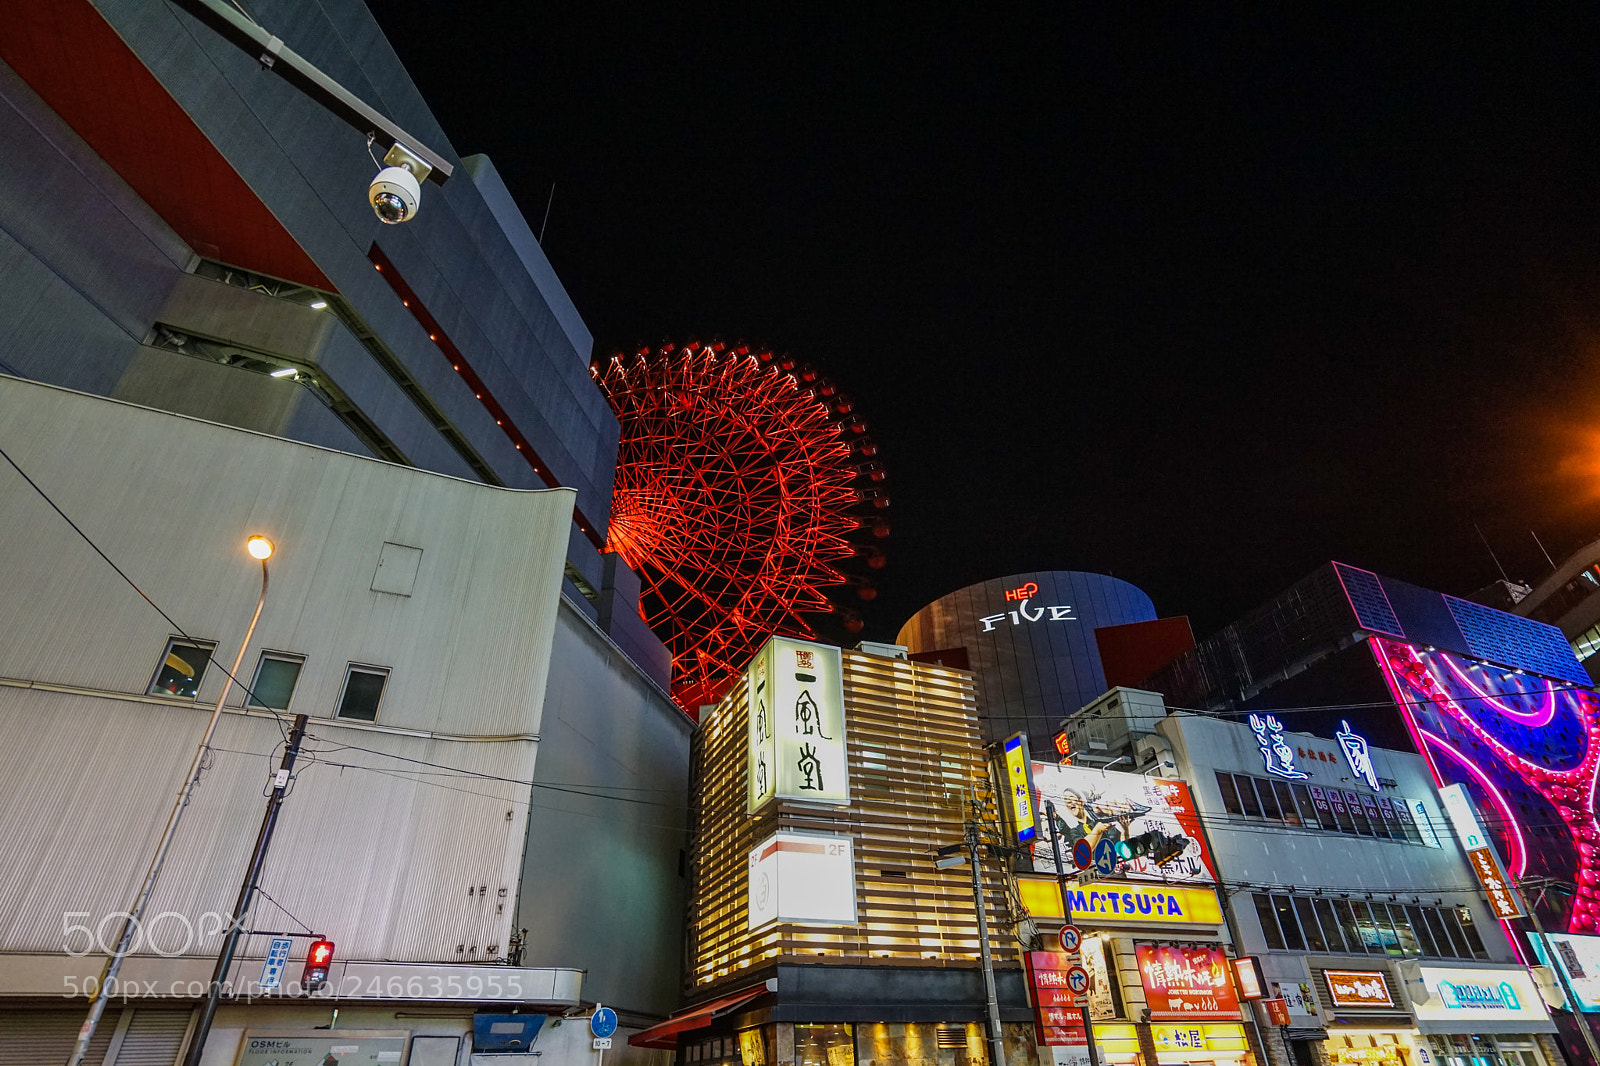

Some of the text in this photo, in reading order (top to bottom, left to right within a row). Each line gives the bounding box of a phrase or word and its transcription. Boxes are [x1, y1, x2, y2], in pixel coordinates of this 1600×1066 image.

[1005, 582, 1038, 601] HEP
[979, 599, 1077, 632] FIVE
[795, 673, 832, 791] 一風堂
[829, 844, 845, 856] 2F
[1067, 889, 1183, 917] MATSUYA
[251, 1040, 291, 1049] OSMビル
[1174, 1029, 1203, 1048] 松屋
